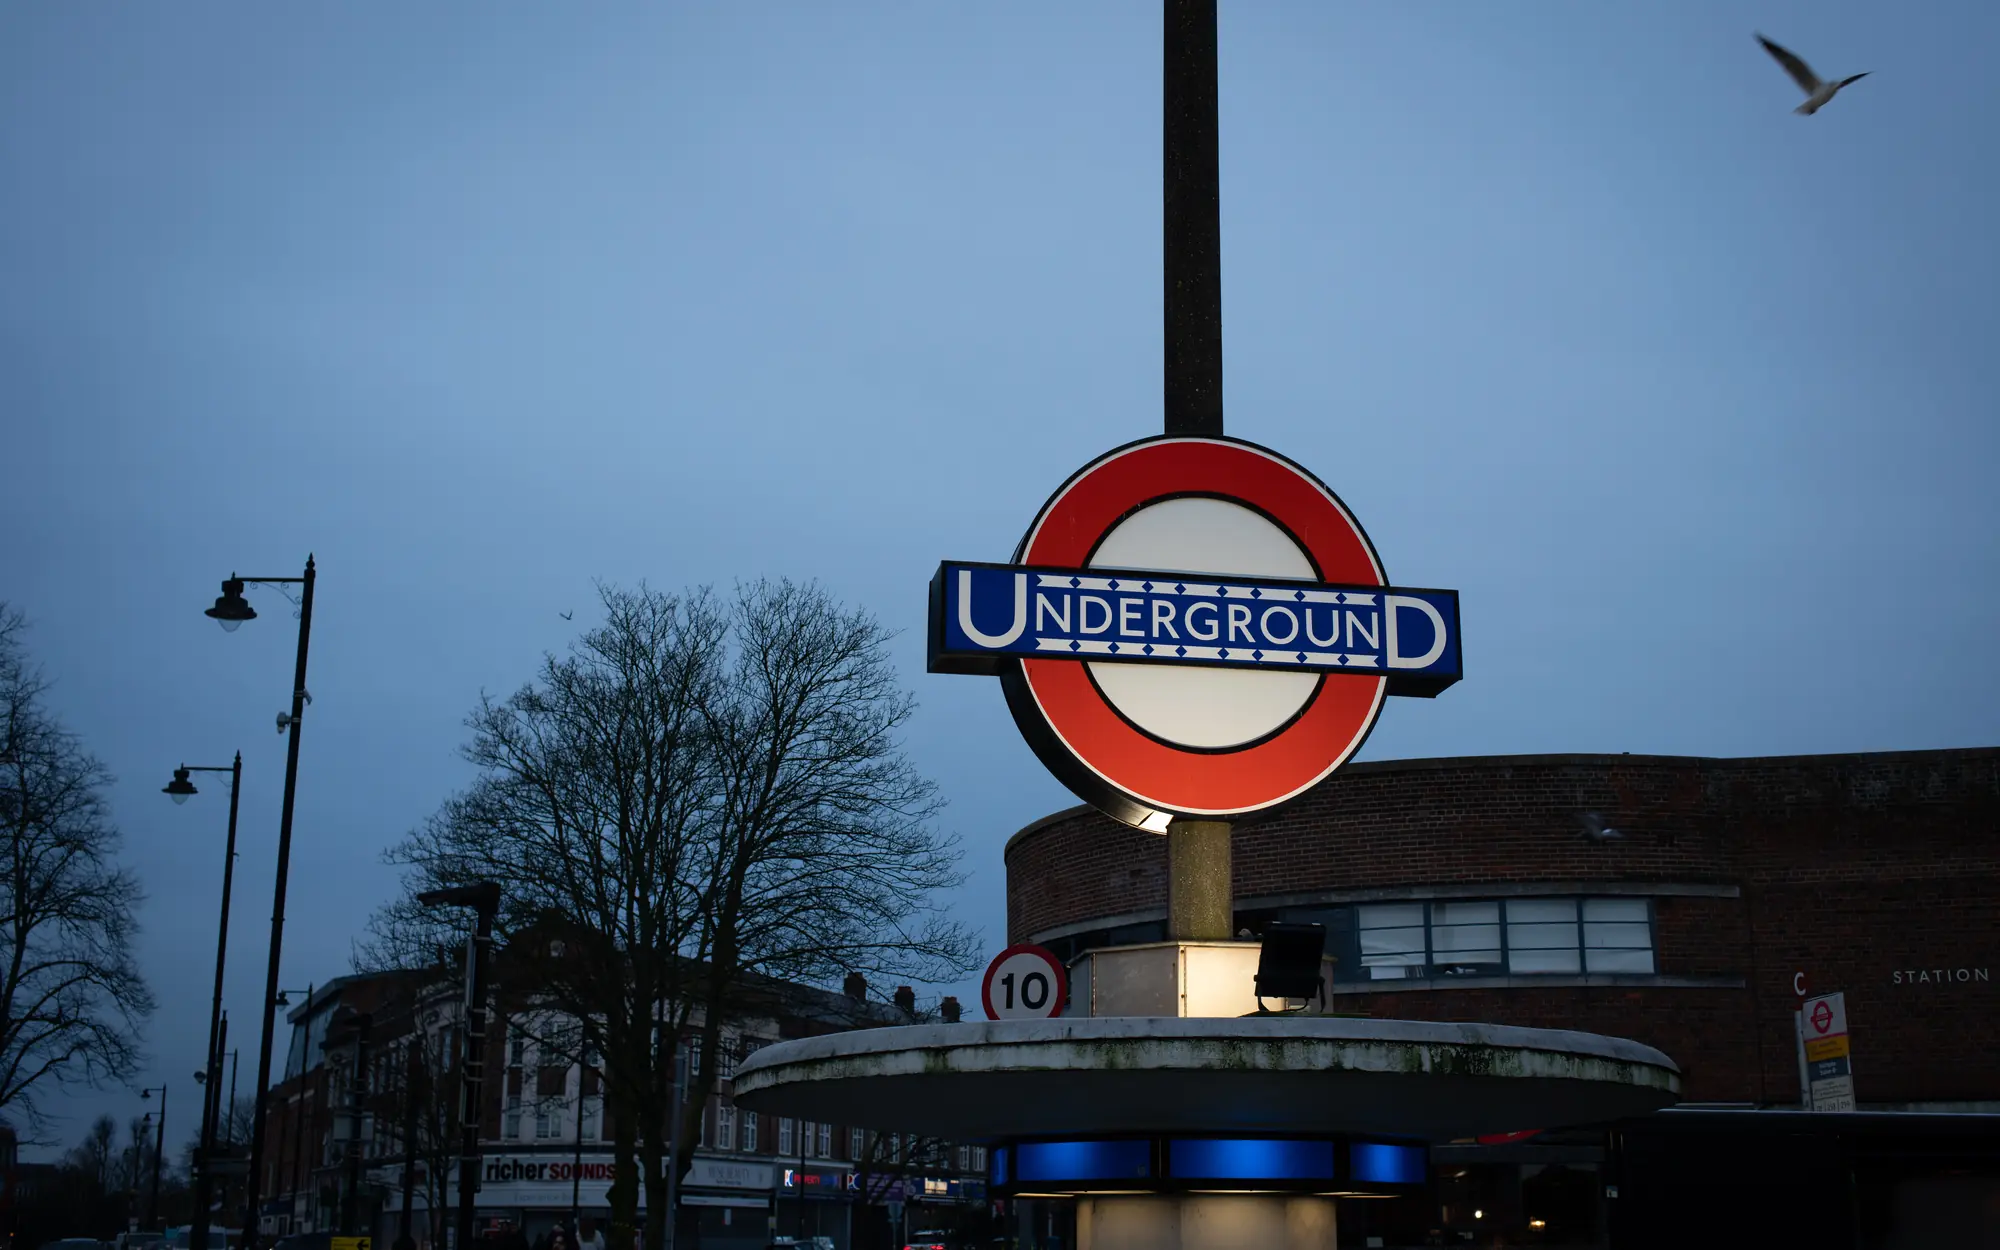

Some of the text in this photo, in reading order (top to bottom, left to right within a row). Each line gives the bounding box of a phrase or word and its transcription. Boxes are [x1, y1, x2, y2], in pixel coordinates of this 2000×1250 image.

[958, 569, 1447, 669] UNDERGROUND
[1794, 972, 1806, 996] C
[1892, 967, 1990, 986] STATION
[1001, 971, 1049, 1010] 10
[487, 1158, 616, 1180] richer SOUNDS
